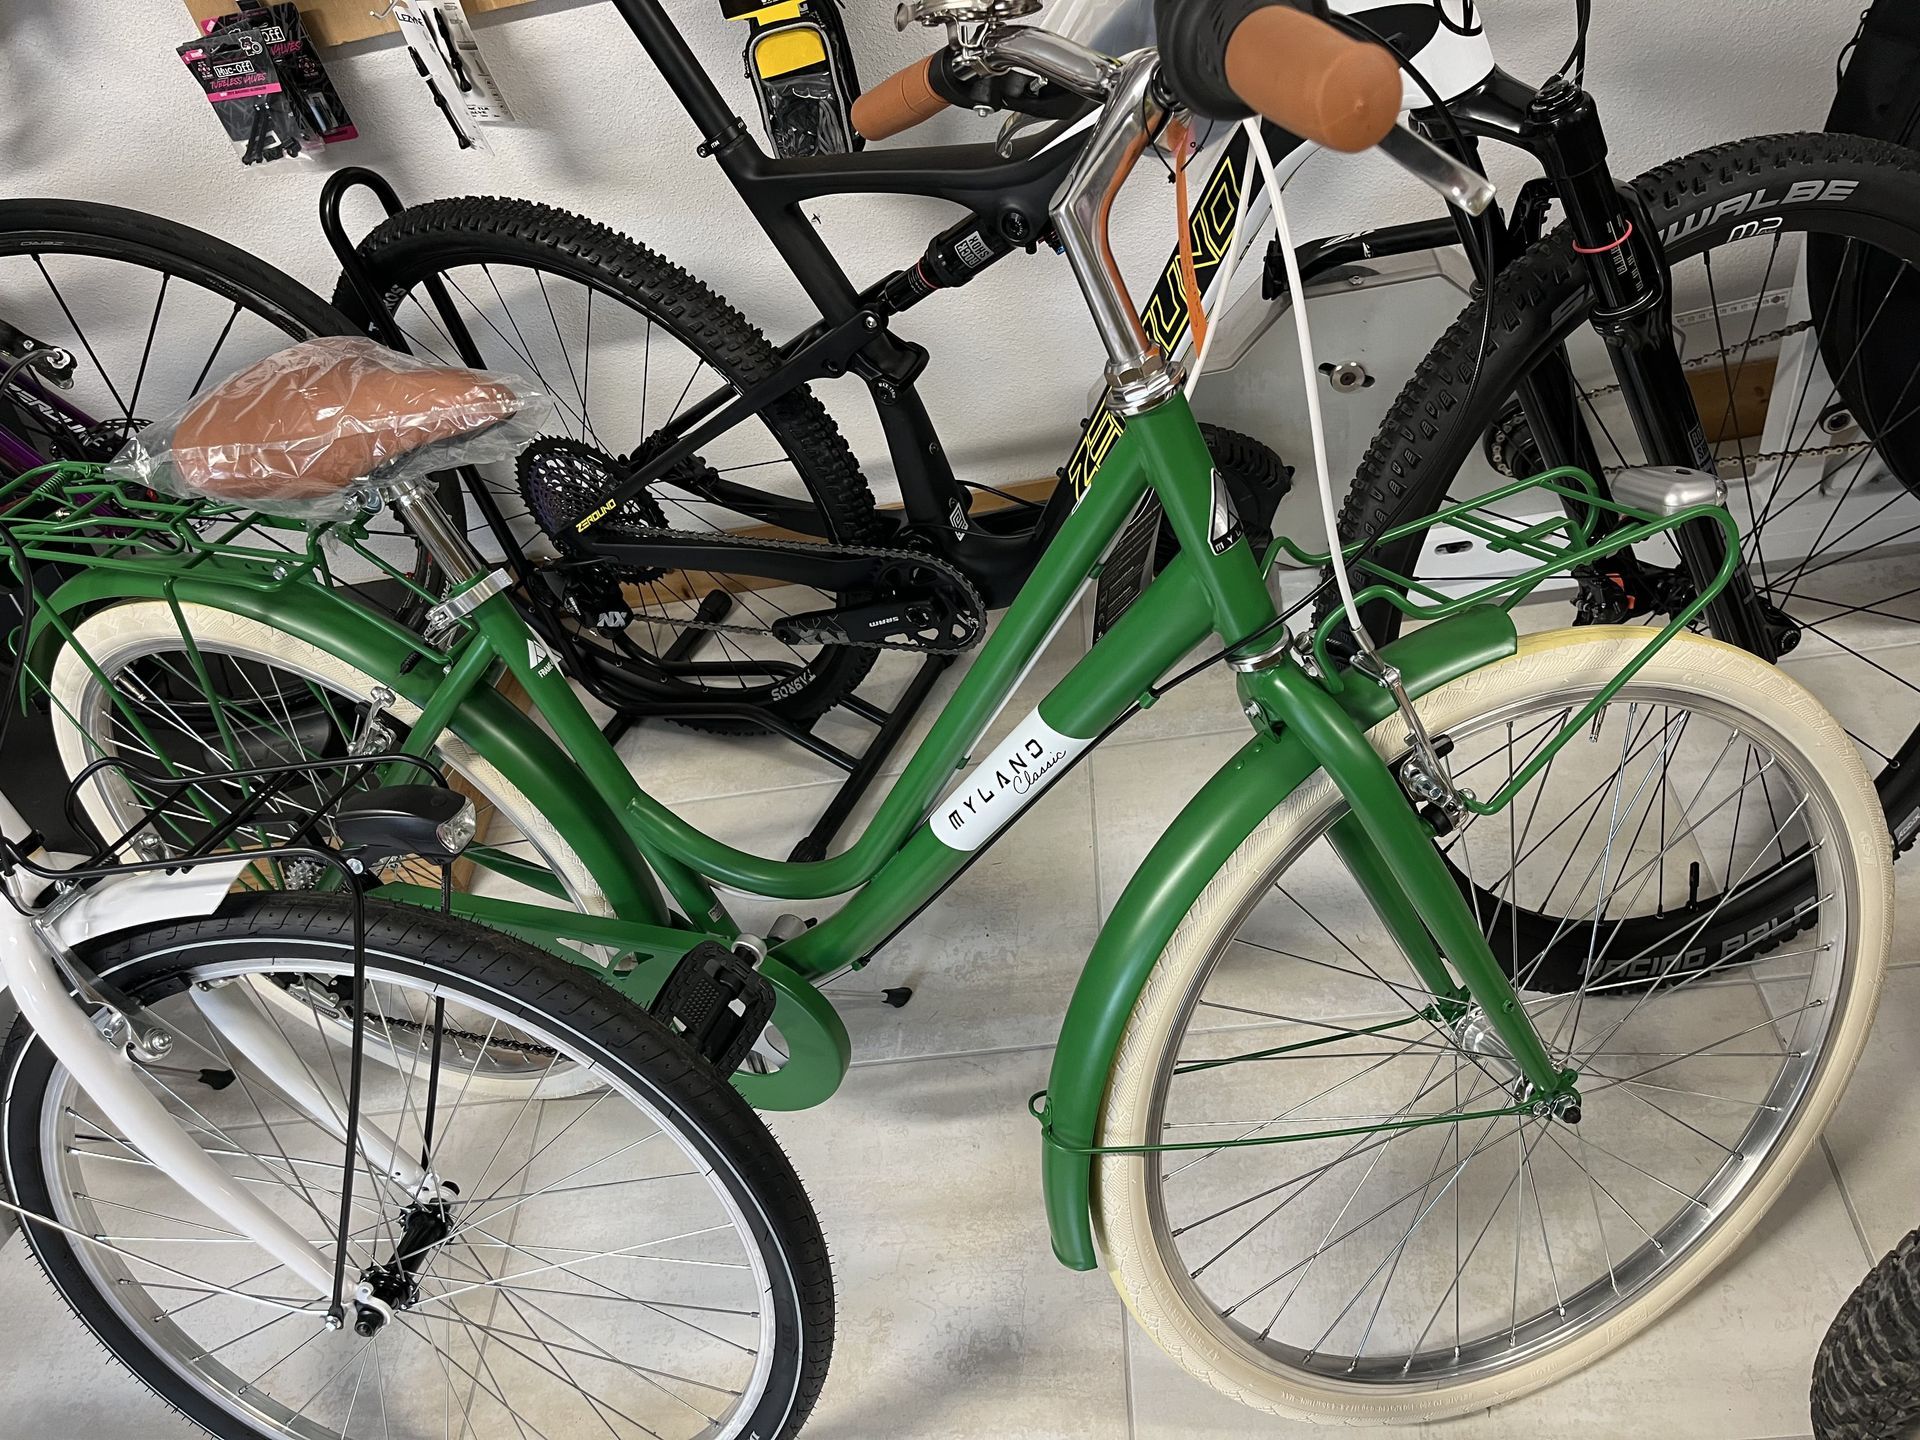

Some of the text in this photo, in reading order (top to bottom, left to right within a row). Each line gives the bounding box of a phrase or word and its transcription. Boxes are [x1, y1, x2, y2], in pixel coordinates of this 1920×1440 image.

[209, 72, 267, 89] TUBELESS VALVES
[216, 60, 254, 77] Muc-Off
[957, 242, 980, 267] ROCK
[967, 235, 991, 260] SHOX
[596, 611, 628, 628] NX
[868, 615, 900, 628] SRAM
[948, 738, 1044, 831] MYLAND
[1012, 749, 1067, 795] Classic
[1720, 895, 1816, 959] RALP
